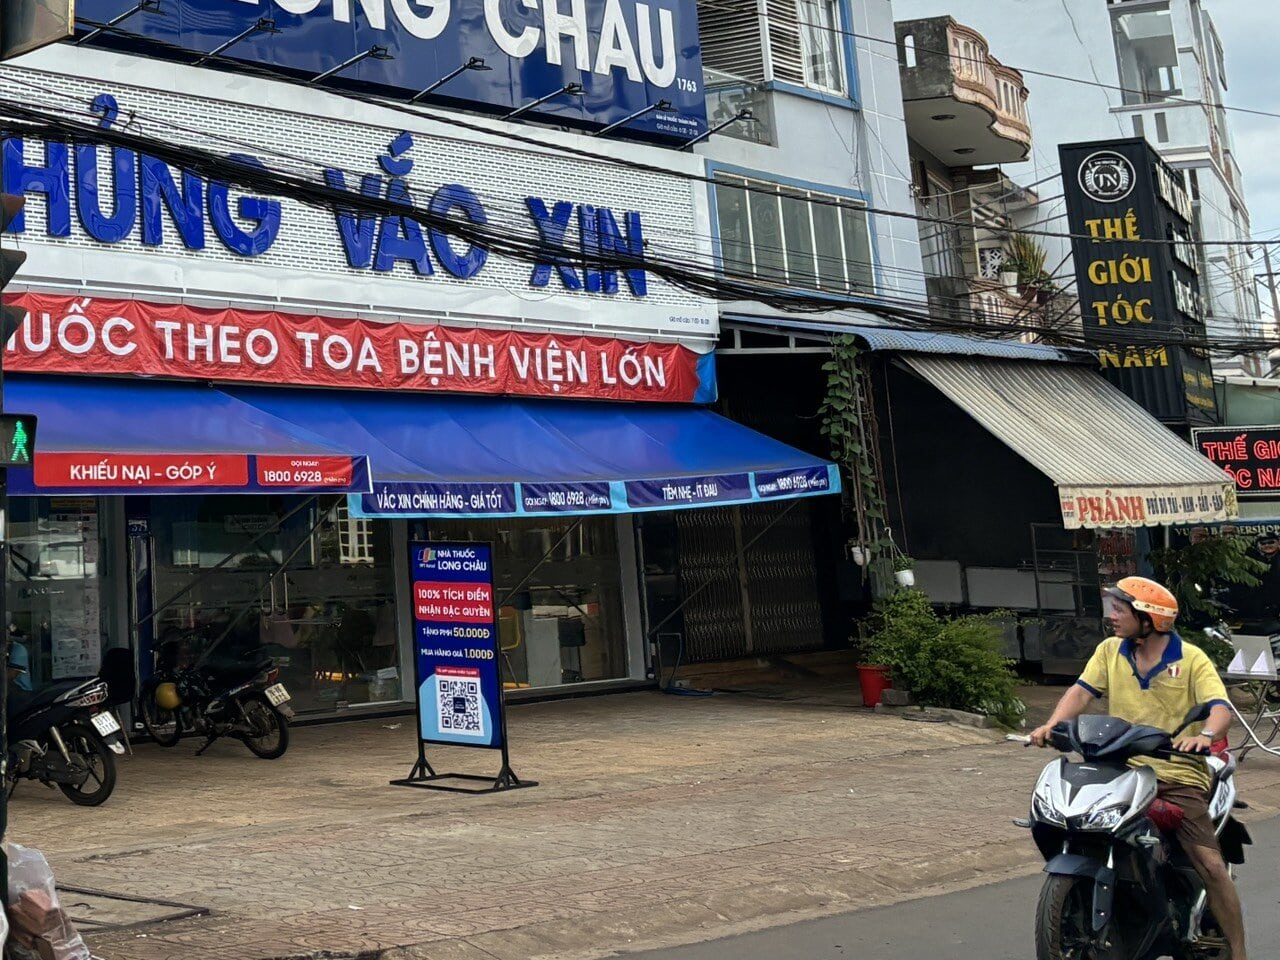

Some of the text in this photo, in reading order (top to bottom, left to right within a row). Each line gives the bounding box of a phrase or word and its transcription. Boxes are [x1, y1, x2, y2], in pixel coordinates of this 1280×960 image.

[677, 77, 697, 93] 1763
[323, 130, 489, 279] VẮC
[525, 195, 647, 297] XIN
[1085, 208, 1140, 243] THẾ
[1087, 253, 1152, 285] GIỚI
[1092, 293, 1153, 326] TÓC
[6, 298, 137, 356] UỐC
[154, 320, 280, 366] THEO
[296, 332, 383, 374] TOA
[398, 332, 496, 386] BỆNH
[509, 342, 589, 392] VIỆN
[600, 342, 667, 388] LỚN
[1202, 433, 1280, 461] THẾ GI
[70, 458, 118, 480] KHIẾU
[122, 465, 150, 484] NẠI
[165, 461, 203, 480] GÓP
[206, 463, 217, 480] Ý
[263, 470, 291, 483] 1800
[293, 470, 322, 483] 6928
[377, 486, 397, 510] VẮC
[398, 493, 412, 509] XIN
[412, 490, 439, 510] CHÍNH
[470, 490, 486, 510] GIÁ
[486, 488, 503, 510] TỐT
[548, 490, 565, 507] 1800
[566, 491, 585, 506] 6928
[662, 484, 680, 501] TIÊM
[438, 548, 475, 558] NHÀ THUỐC
[438, 560, 461, 571] LONG
[462, 559, 487, 571] CHÂU
[418, 588, 441, 600] 100%
[443, 587, 465, 600] TÍCH
[418, 603, 490, 618] NHẬN ĐẶC QUYỀN
[453, 627, 490, 639] 50.000Đ
[464, 648, 494, 660] 1.000Đ
